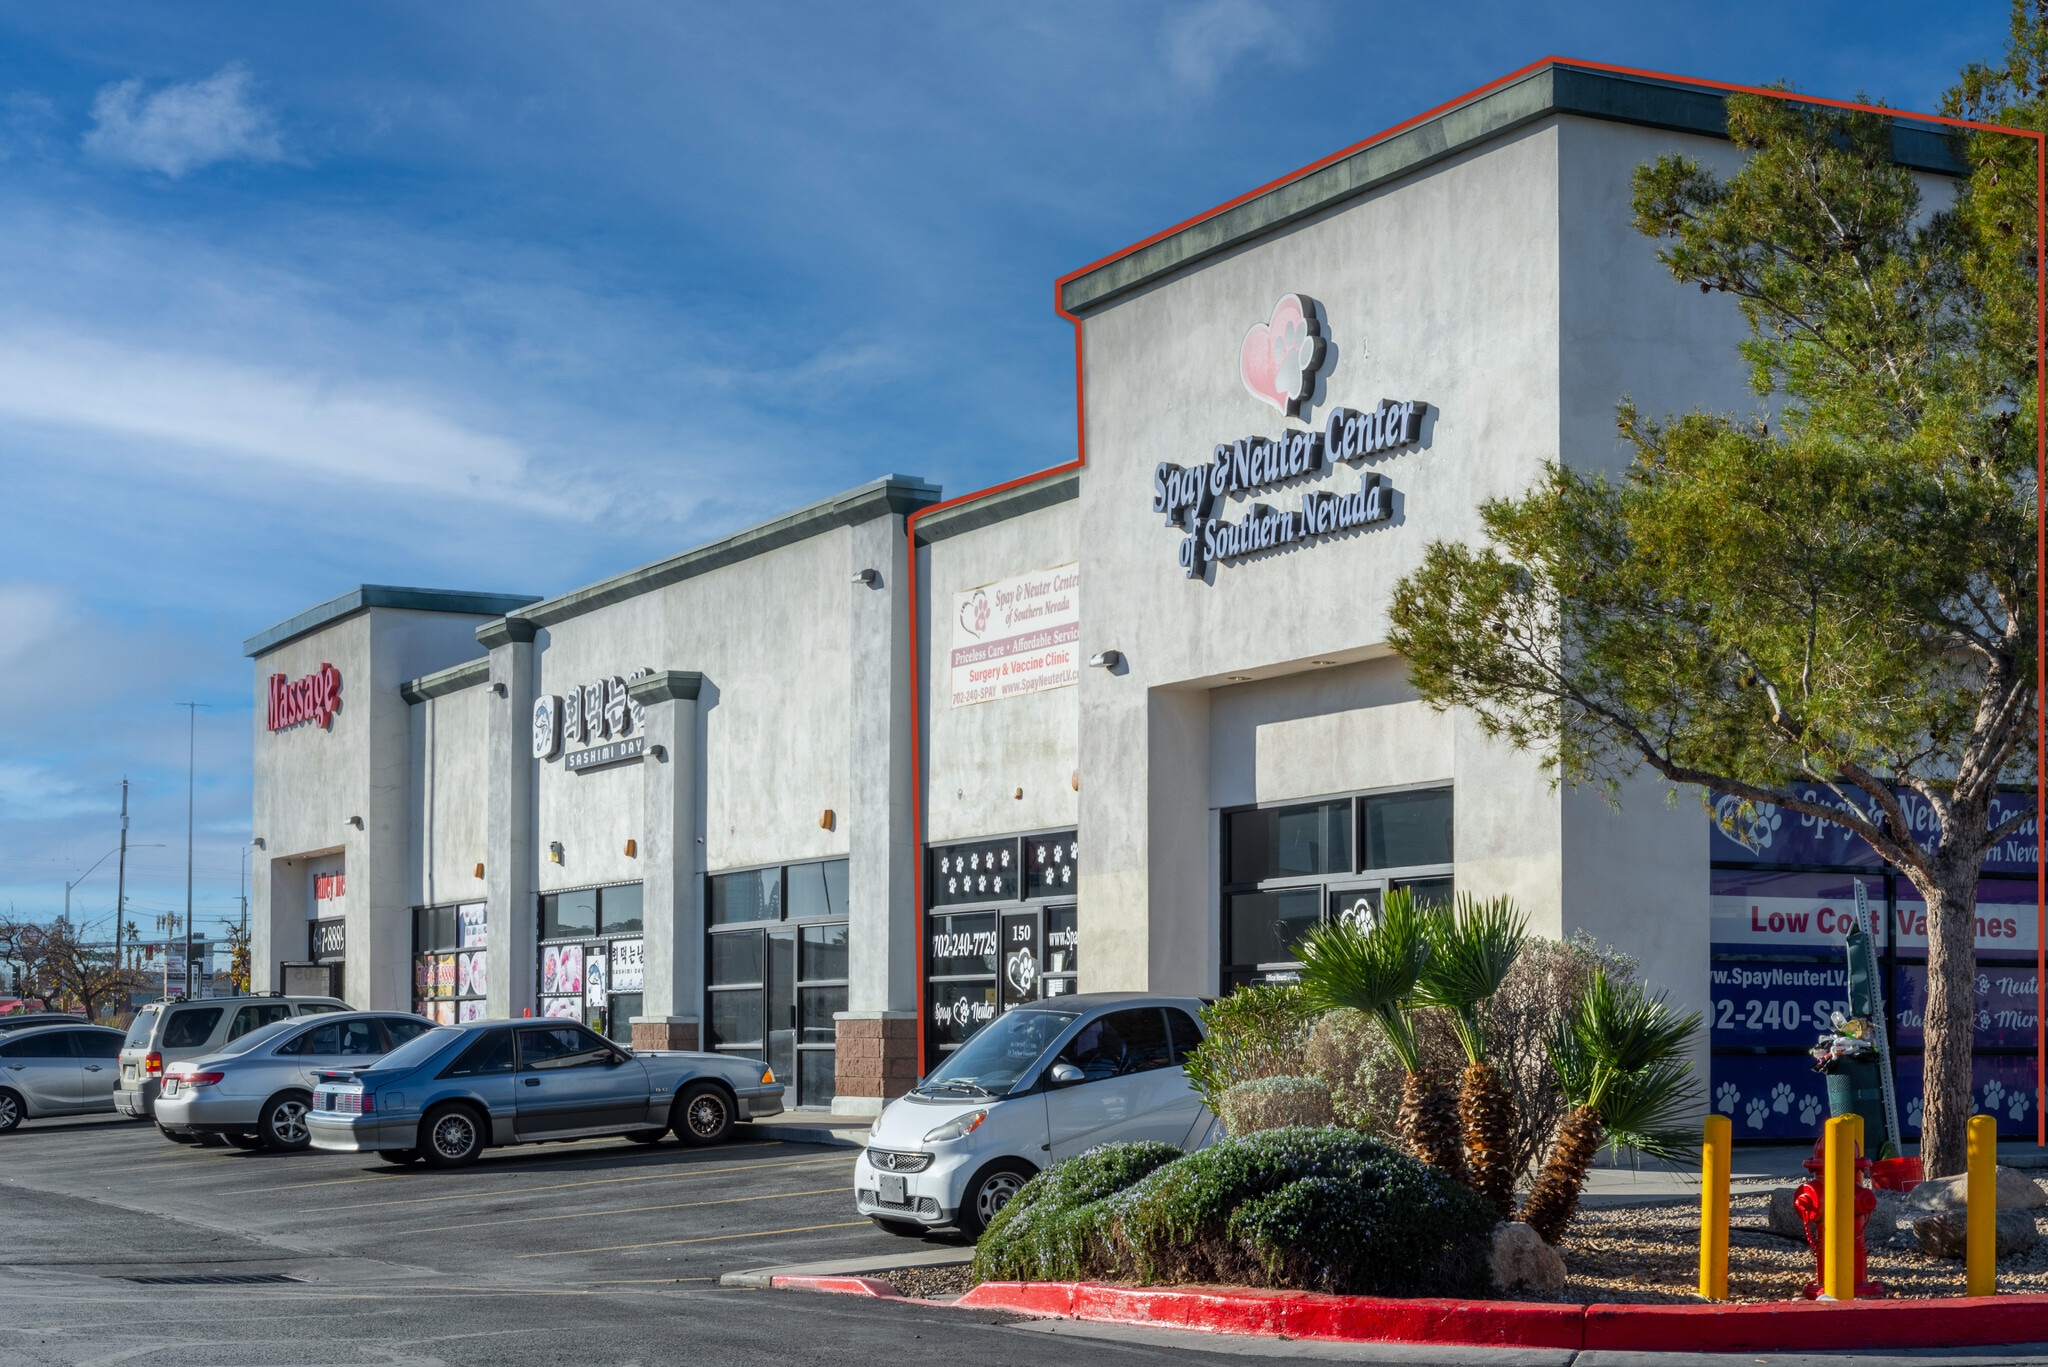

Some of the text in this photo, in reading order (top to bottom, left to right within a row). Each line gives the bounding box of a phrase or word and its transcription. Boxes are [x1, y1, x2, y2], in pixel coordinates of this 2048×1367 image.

[1153, 398, 1418, 527] Spay & Neuter Center
[1179, 472, 1384, 579] of Southern Nevada
[996, 590, 1014, 611] Spay
[1016, 585, 1023, 601] &
[1024, 581, 1051, 600] Neuter
[1005, 596, 1070, 628] of Southern Nevada
[955, 650, 986, 665] Priceless
[987, 645, 1005, 657] Care
[1012, 632, 1051, 653] Affordable
[969, 650, 1070, 683] Surgery & Vaccine Clinic
[266, 663, 333, 732] Massage
[953, 685, 996, 705] 702-240-SPAY
[569, 739, 642, 767] SASHIMI DAY
[1012, 925, 1031, 941] 150
[1751, 905, 1809, 933] Low
[1897, 909, 2017, 938] Vanes
[933, 931, 997, 958] 702-240-7729
[1710, 967, 1848, 989] w.SpayNeuterLV.
[935, 1000, 995, 1026] Spay Neuter
